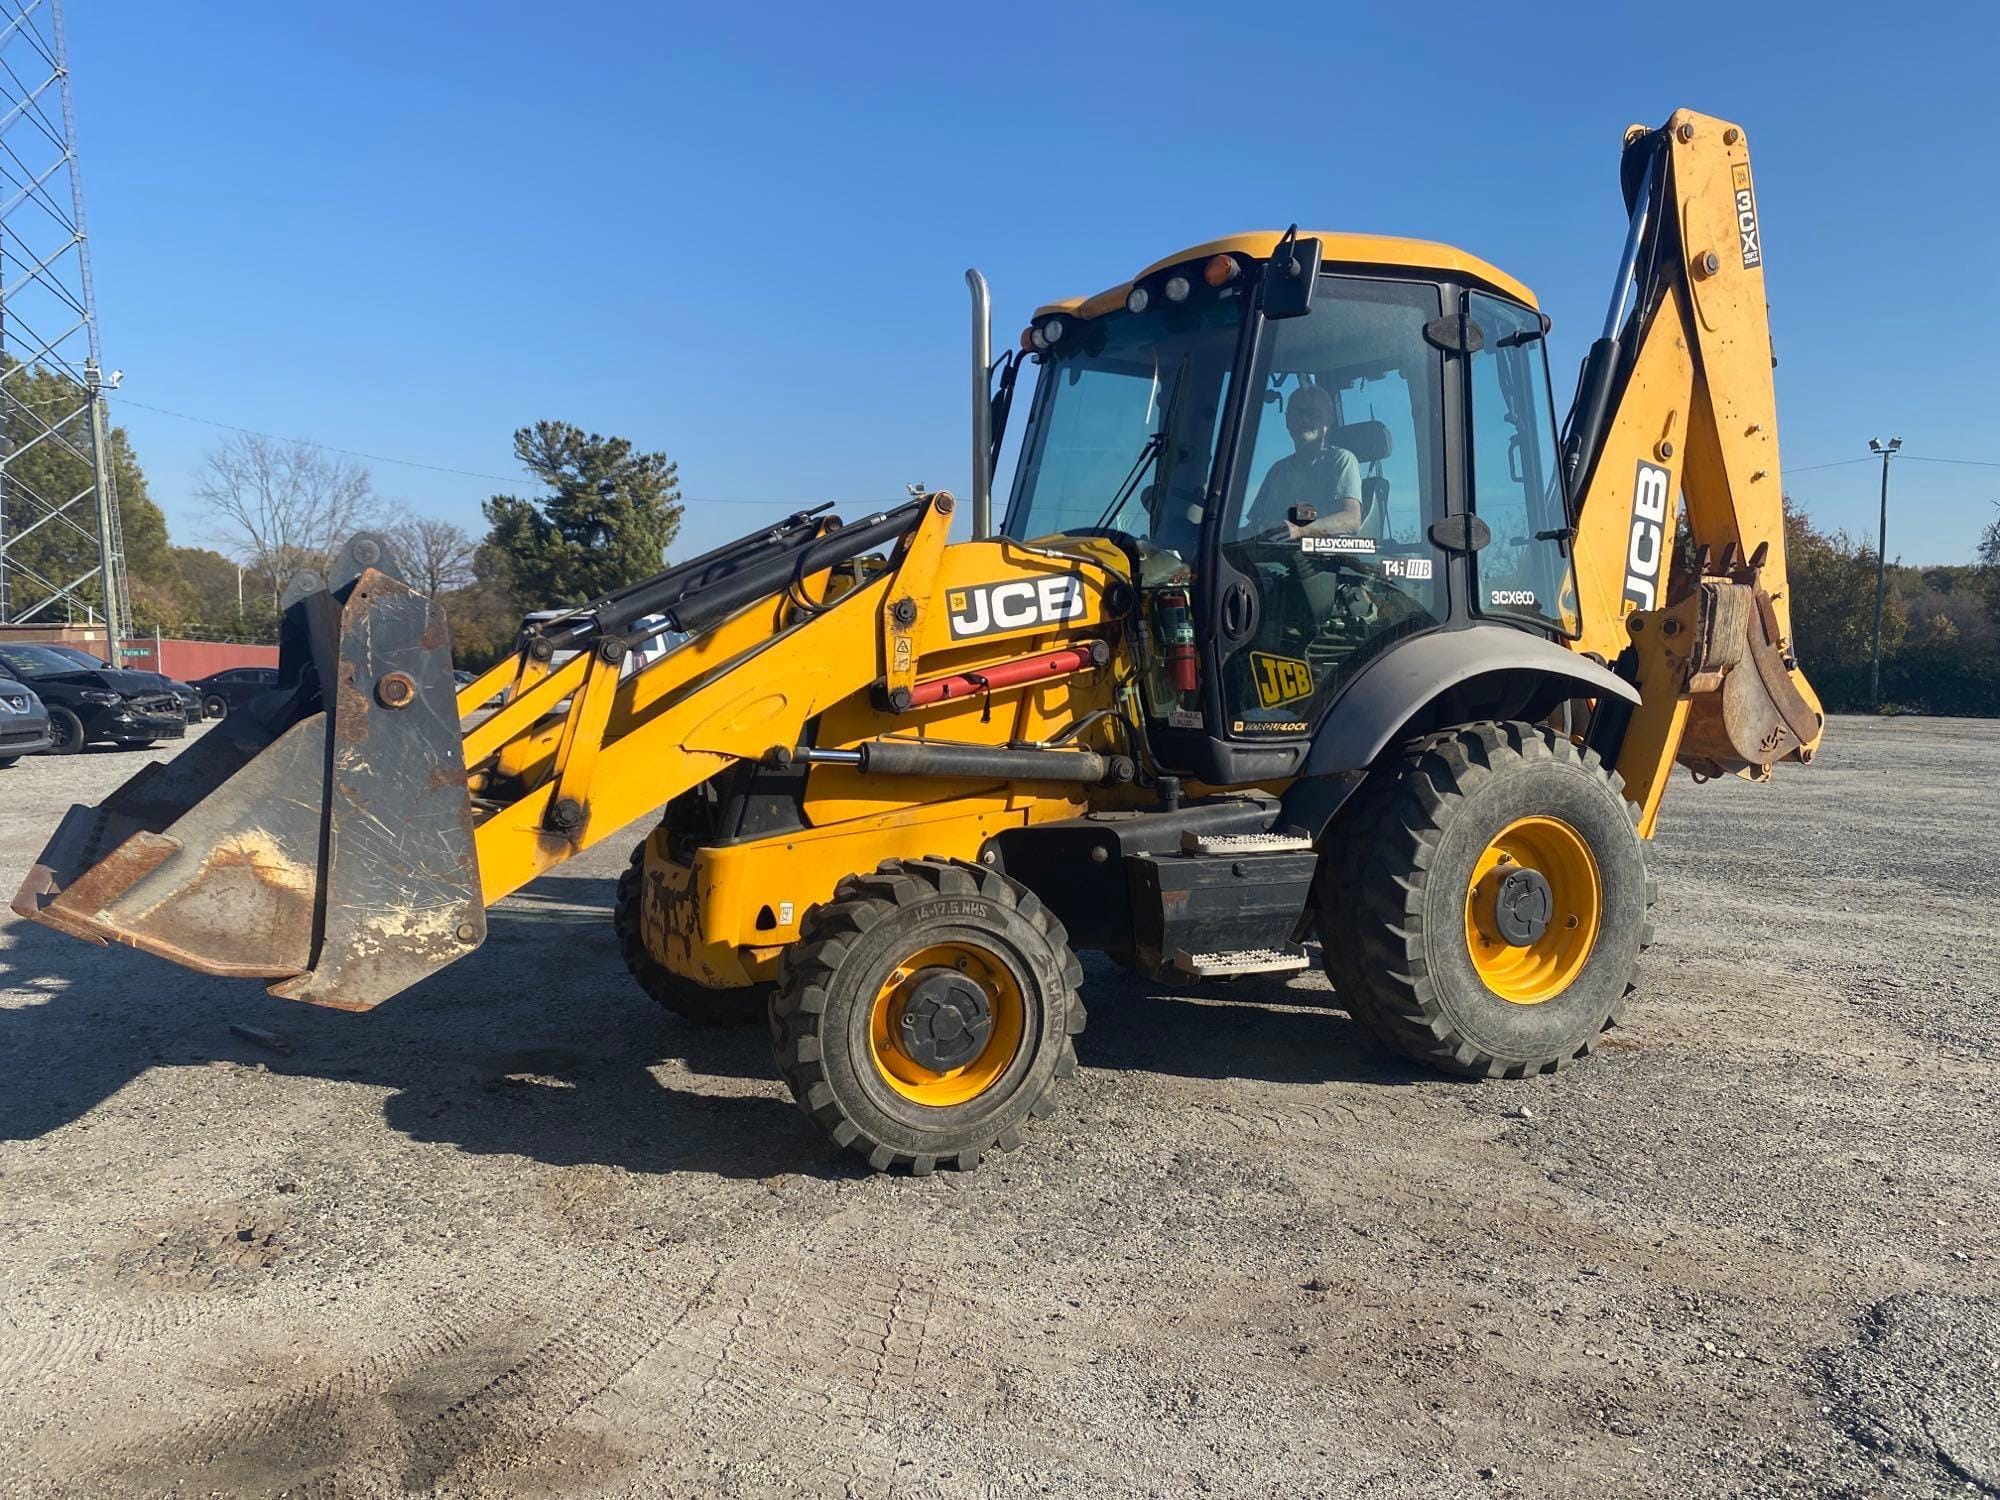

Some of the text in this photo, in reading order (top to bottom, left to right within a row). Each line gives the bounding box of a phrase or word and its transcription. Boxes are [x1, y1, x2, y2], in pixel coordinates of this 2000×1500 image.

[1736, 191, 1758, 253] 3CX
[1315, 538, 1376, 551] EASYCONTROL
[1626, 466, 1667, 611] JCB
[1382, 560, 1405, 576] T4i
[953, 576, 1083, 635] JCB
[1261, 657, 1311, 703] JCB
[915, 901, 988, 921] 14-17.5 NHS
[1046, 979, 1063, 1042] CAMSO
